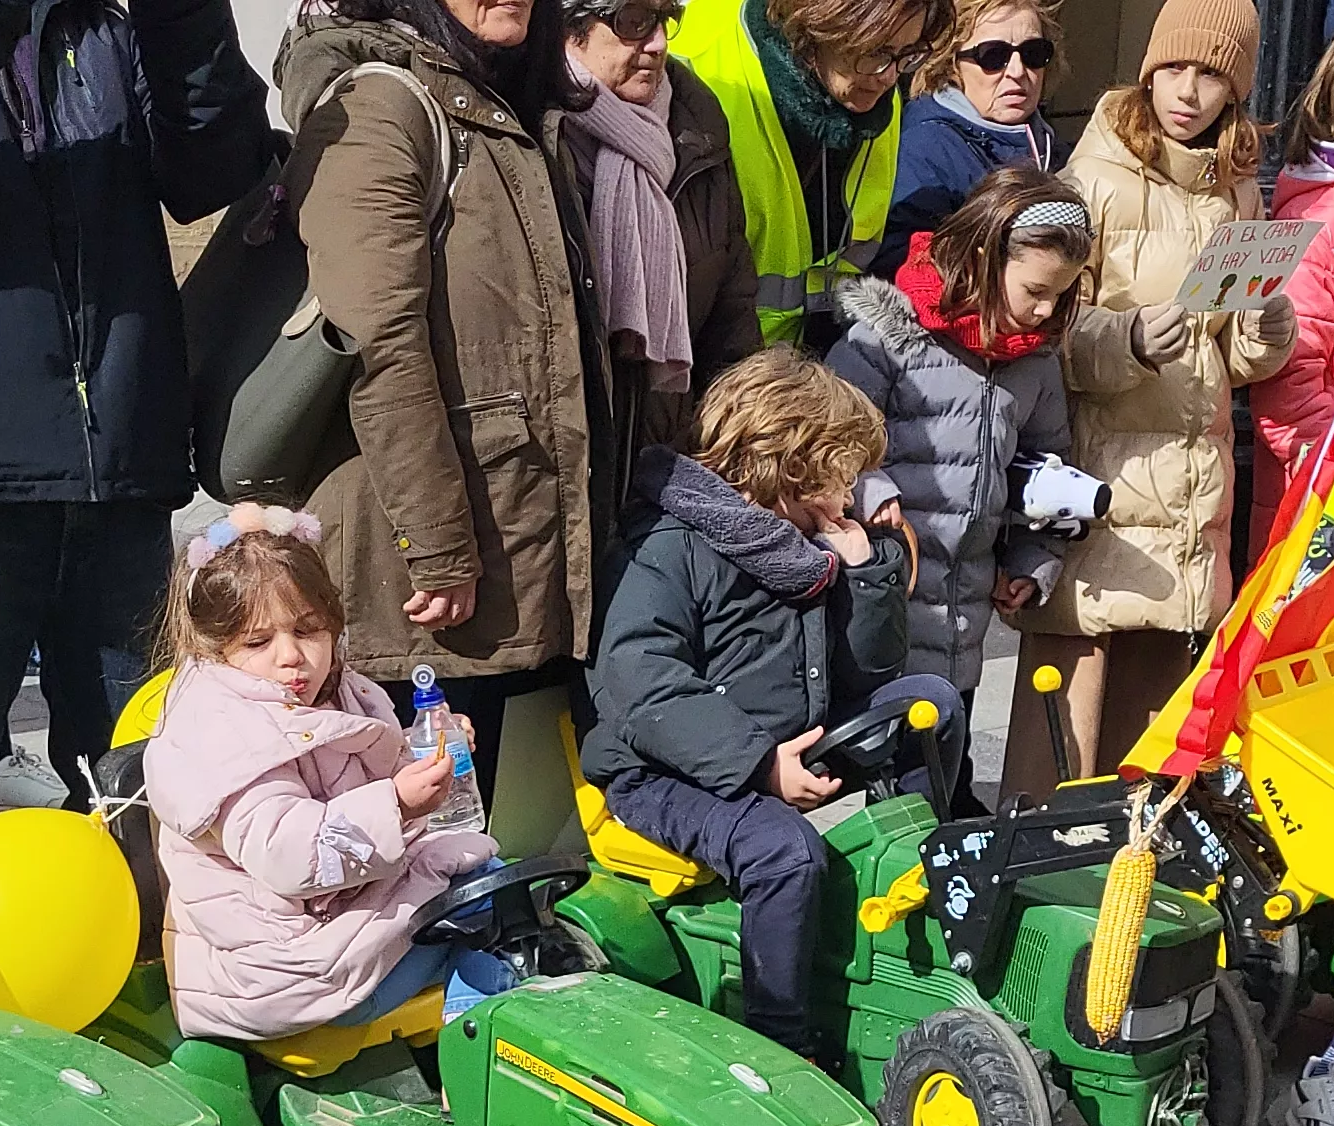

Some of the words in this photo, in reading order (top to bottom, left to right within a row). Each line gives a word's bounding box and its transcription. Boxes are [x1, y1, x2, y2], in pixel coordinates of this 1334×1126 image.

[1206, 226, 1235, 250] SIN
[1240, 226, 1257, 243] EL
[1263, 222, 1304, 240] CAMPO
[1191, 254, 1214, 273] NO
[1219, 250, 1252, 271] HAY
[1260, 244, 1297, 265] VIDA
[499, 1044, 524, 1067] JOHN
[524, 1056, 556, 1082] DEERE
